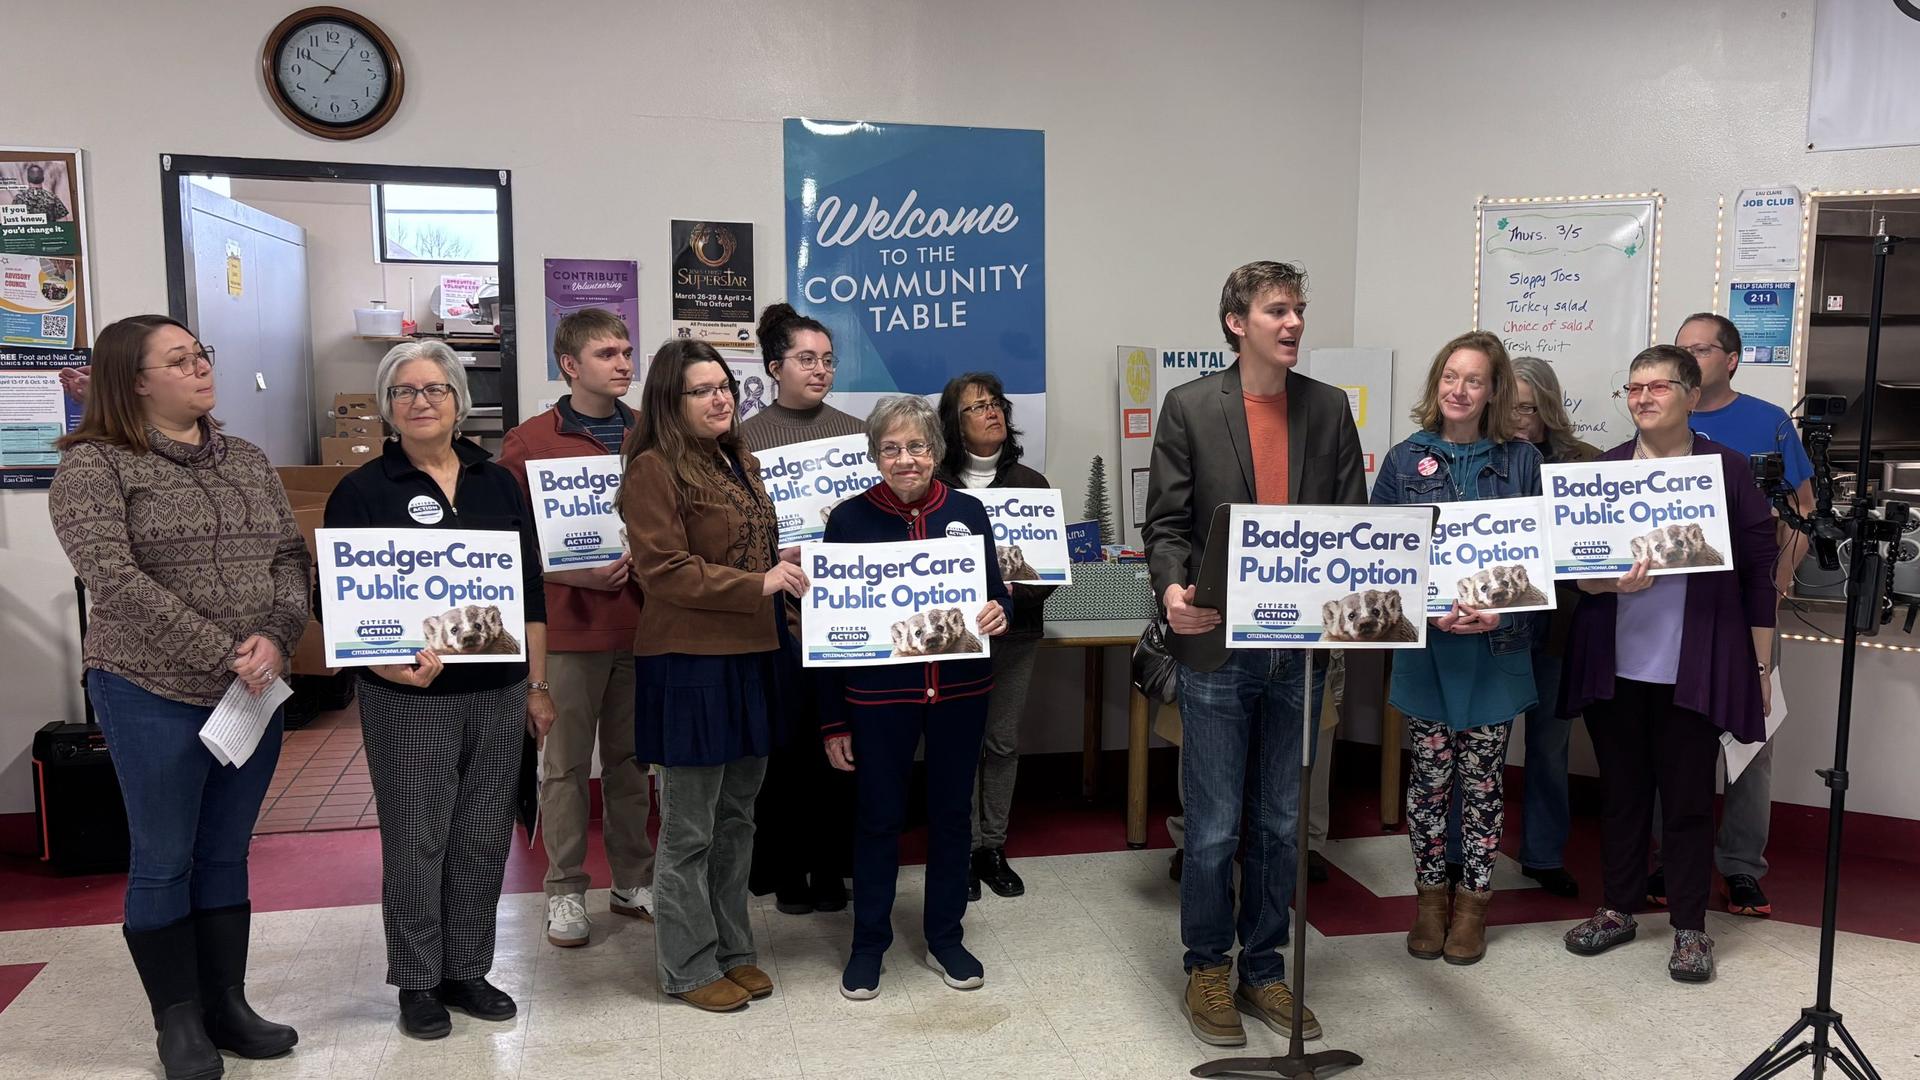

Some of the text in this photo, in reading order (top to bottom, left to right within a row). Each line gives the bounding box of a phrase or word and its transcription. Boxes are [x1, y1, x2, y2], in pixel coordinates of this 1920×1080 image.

[310, 35, 319, 47] 11
[326, 31, 340, 44] 12
[296, 47, 311, 60] 10
[291, 64, 301, 75] 9
[330, 102, 340, 113] 6
[1743, 198, 1794, 208] JOB CLUB
[3, 216, 19, 224] just
[816, 189, 1019, 248] Welcome
[2, 226, 26, 236] you'd
[26, 226, 54, 235] change
[1508, 224, 1582, 241] Thurs. 3/5
[880, 245, 955, 266] TO THE
[553, 271, 628, 281] CONTRIBUTE
[571, 281, 622, 291] Volunteering
[678, 267, 747, 289] SUPERSTAR
[804, 264, 1029, 304] COMMUNITY
[1509, 268, 1581, 289] Sloppy Joes
[1523, 290, 1536, 299] or
[869, 301, 967, 333] TABLE
[1507, 299, 1588, 316] Turkey salad
[1503, 319, 1594, 333] Choice of salad
[1503, 338, 1571, 352] Fresh fruit
[1163, 351, 1226, 368] MENTAL
[1564, 390, 1582, 414] by
[1569, 421, 1608, 434] tional
[760, 448, 876, 480] adgerCar
[538, 467, 624, 494] Badge
[1552, 470, 1712, 502] BadgerCare
[543, 495, 614, 518] Public
[986, 498, 1055, 518] erCare
[1555, 499, 1714, 528] Public Option
[992, 523, 1058, 544] Option
[1067, 530, 1086, 540] una
[1242, 520, 1420, 557] BadgerCare
[1432, 514, 1536, 544] gerCare
[334, 540, 513, 575] BadgerCare
[1429, 540, 1539, 568] lic Option
[813, 552, 976, 586] BadgerCare
[1240, 556, 1320, 584] Public
[1326, 558, 1417, 592] Option
[336, 574, 514, 607] Public Option
[813, 582, 976, 612] Public Option
